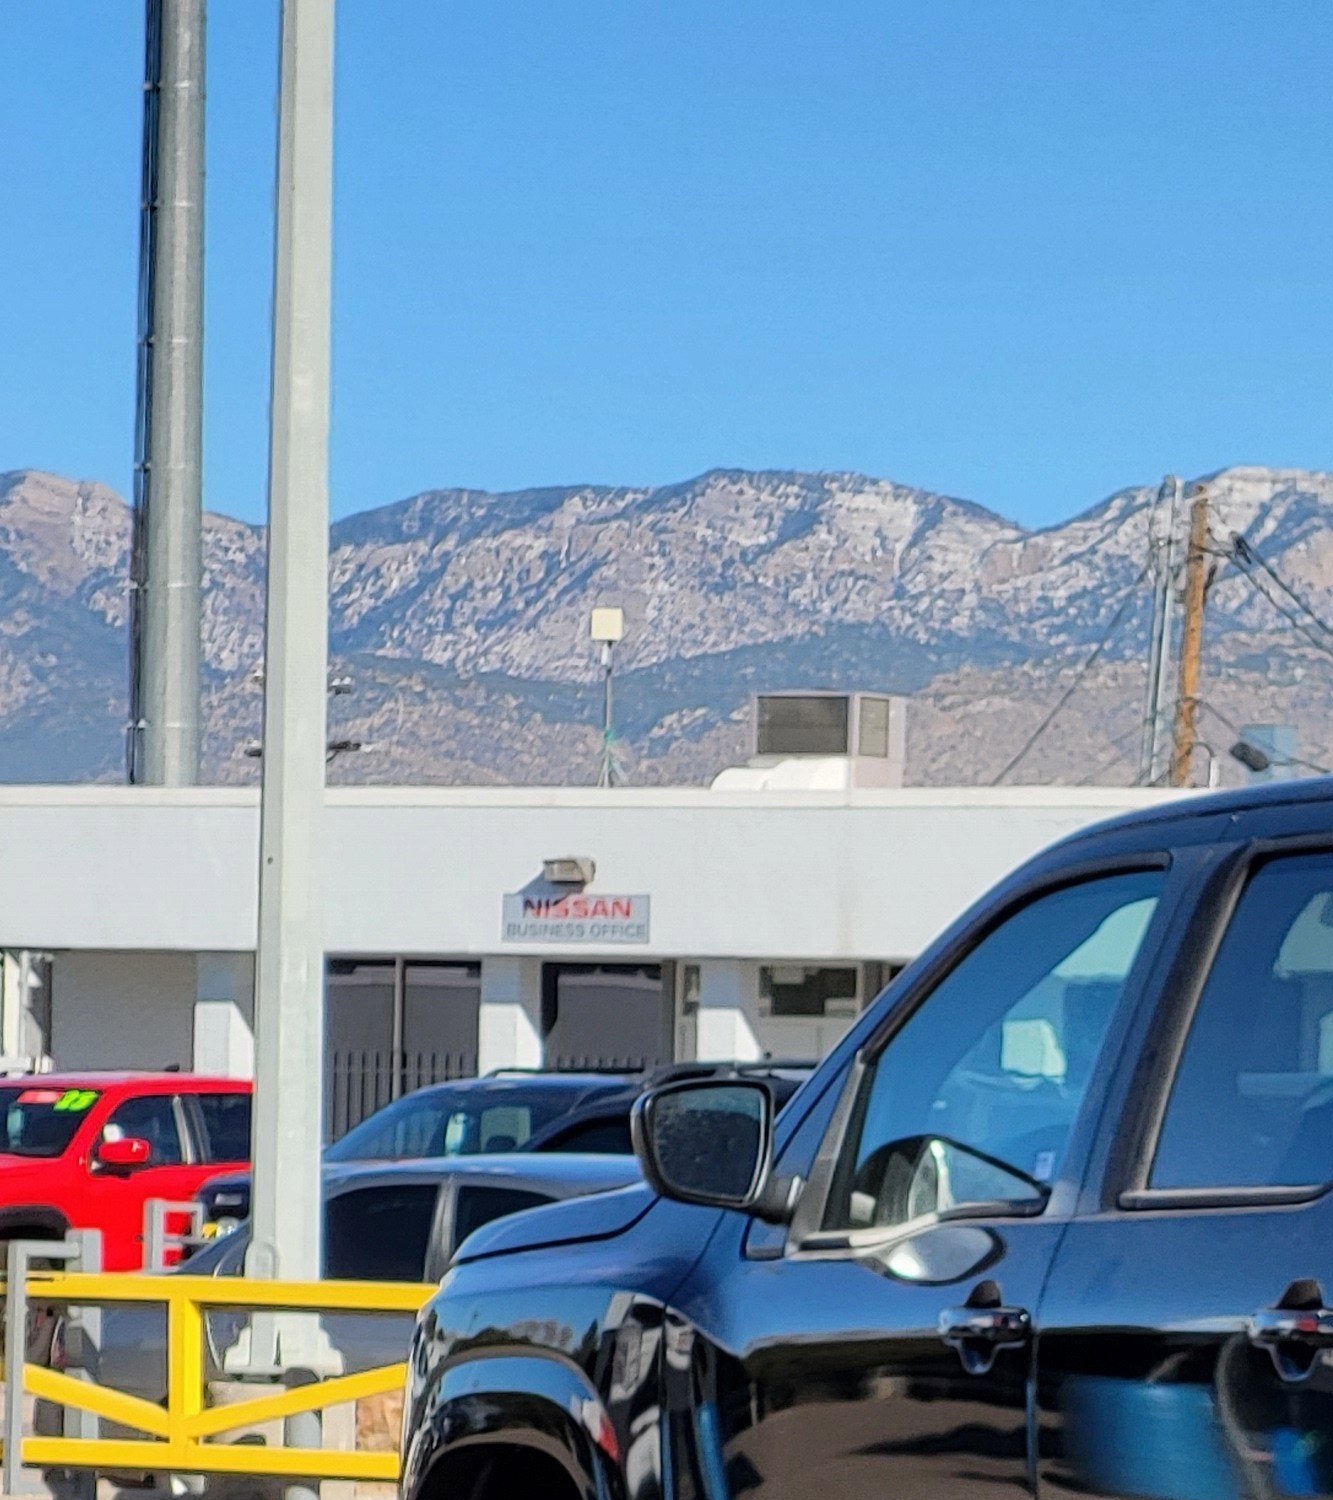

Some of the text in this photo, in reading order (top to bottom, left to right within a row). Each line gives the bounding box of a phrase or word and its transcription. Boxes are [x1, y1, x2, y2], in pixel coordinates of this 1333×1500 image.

[522, 897, 632, 919] NISSAN
[506, 923, 645, 938] BUSINESS OFFICE
